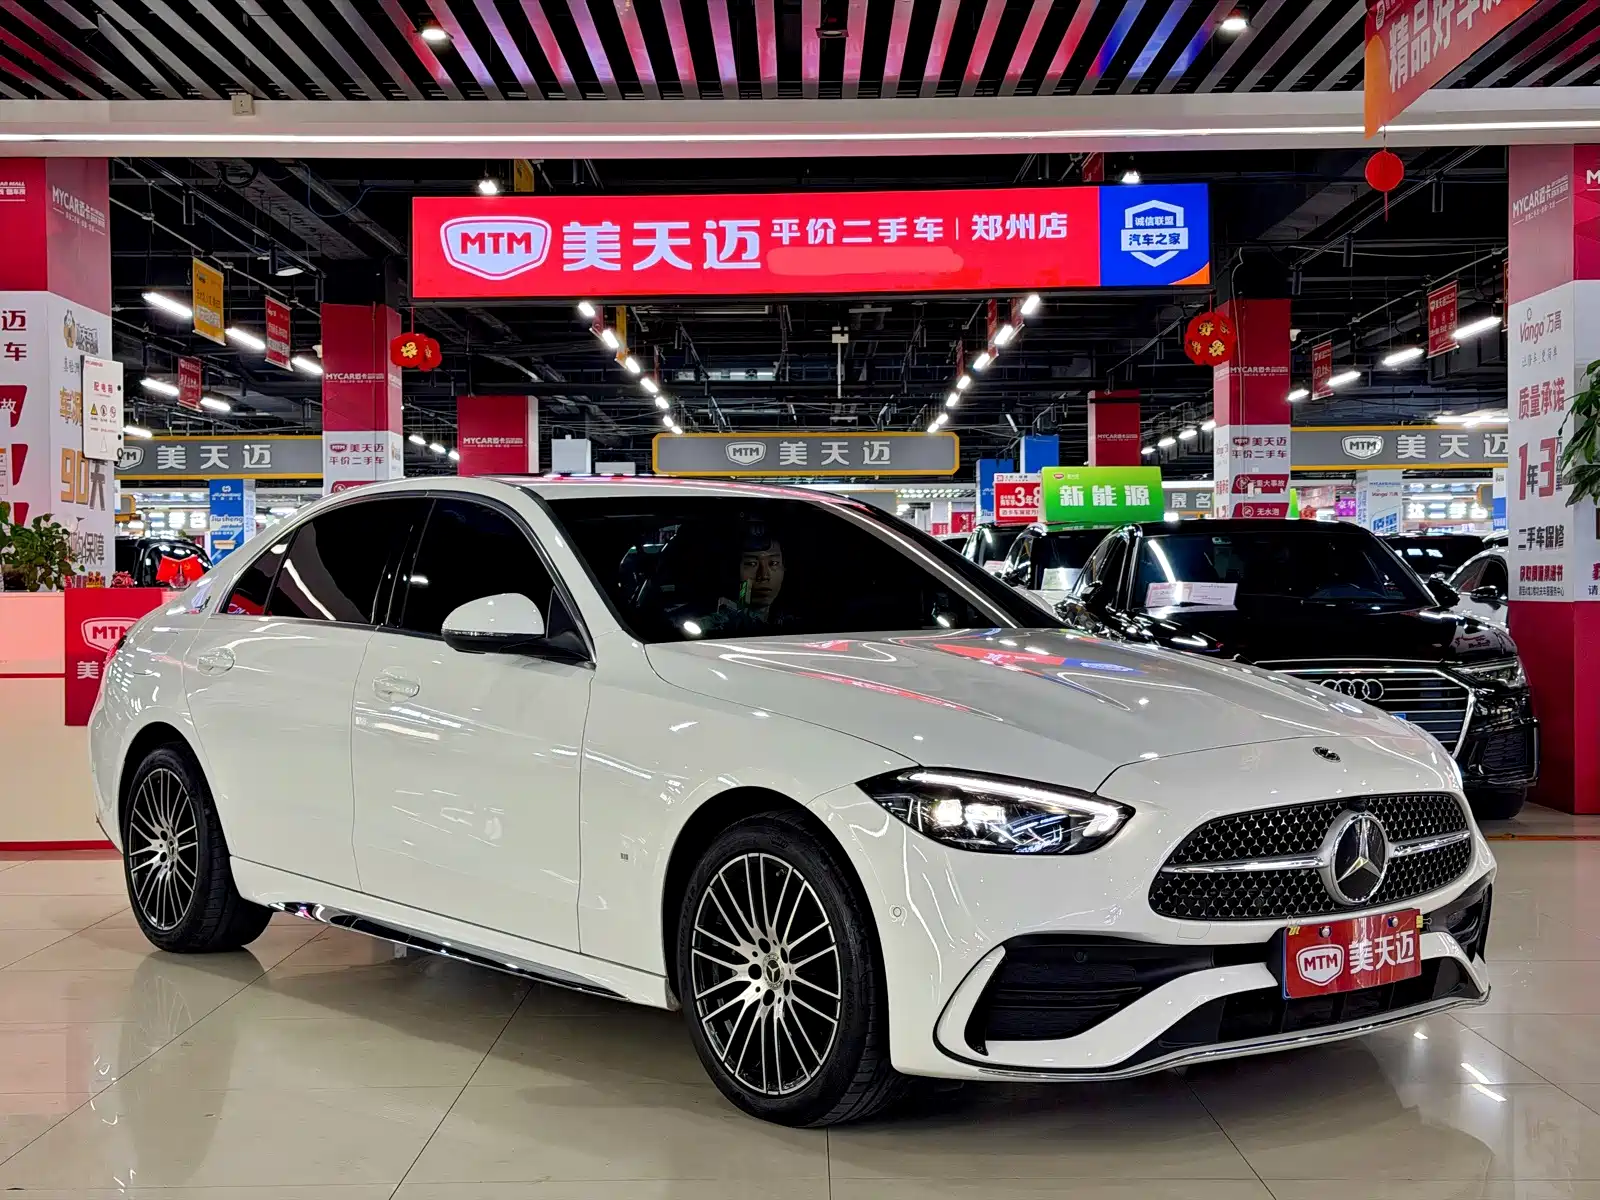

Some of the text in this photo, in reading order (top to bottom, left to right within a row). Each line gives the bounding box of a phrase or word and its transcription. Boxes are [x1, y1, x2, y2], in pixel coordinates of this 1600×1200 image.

[1389, 0, 1503, 94] 精品好
[771, 213, 1068, 245] 平价二手车 郑州店
[1135, 215, 1174, 226] 诚信联盟
[460, 232, 532, 255] MTM
[562, 219, 761, 272] 美天迈
[1129, 232, 1181, 246] 汽车之家
[1, 310, 26, 331] 迈
[4, 341, 27, 361] 车
[1519, 376, 1565, 420] 质量承诺
[350, 443, 385, 453] 美天迈
[733, 446, 759, 456] MTM
[1252, 437, 1287, 447] 美天迈
[1349, 440, 1377, 452] MTM
[1396, 433, 1508, 459] 美天迈
[157, 444, 272, 470] 美天迈
[329, 456, 385, 465] 平价二手车
[779, 440, 891, 466] 美天迈
[1231, 450, 1287, 459] 平价二手车
[1059, 484, 1150, 507] 新能源
[77, 661, 99, 680] 美
[1348, 930, 1415, 974] 美天迈
[1303, 953, 1338, 972] MTM
